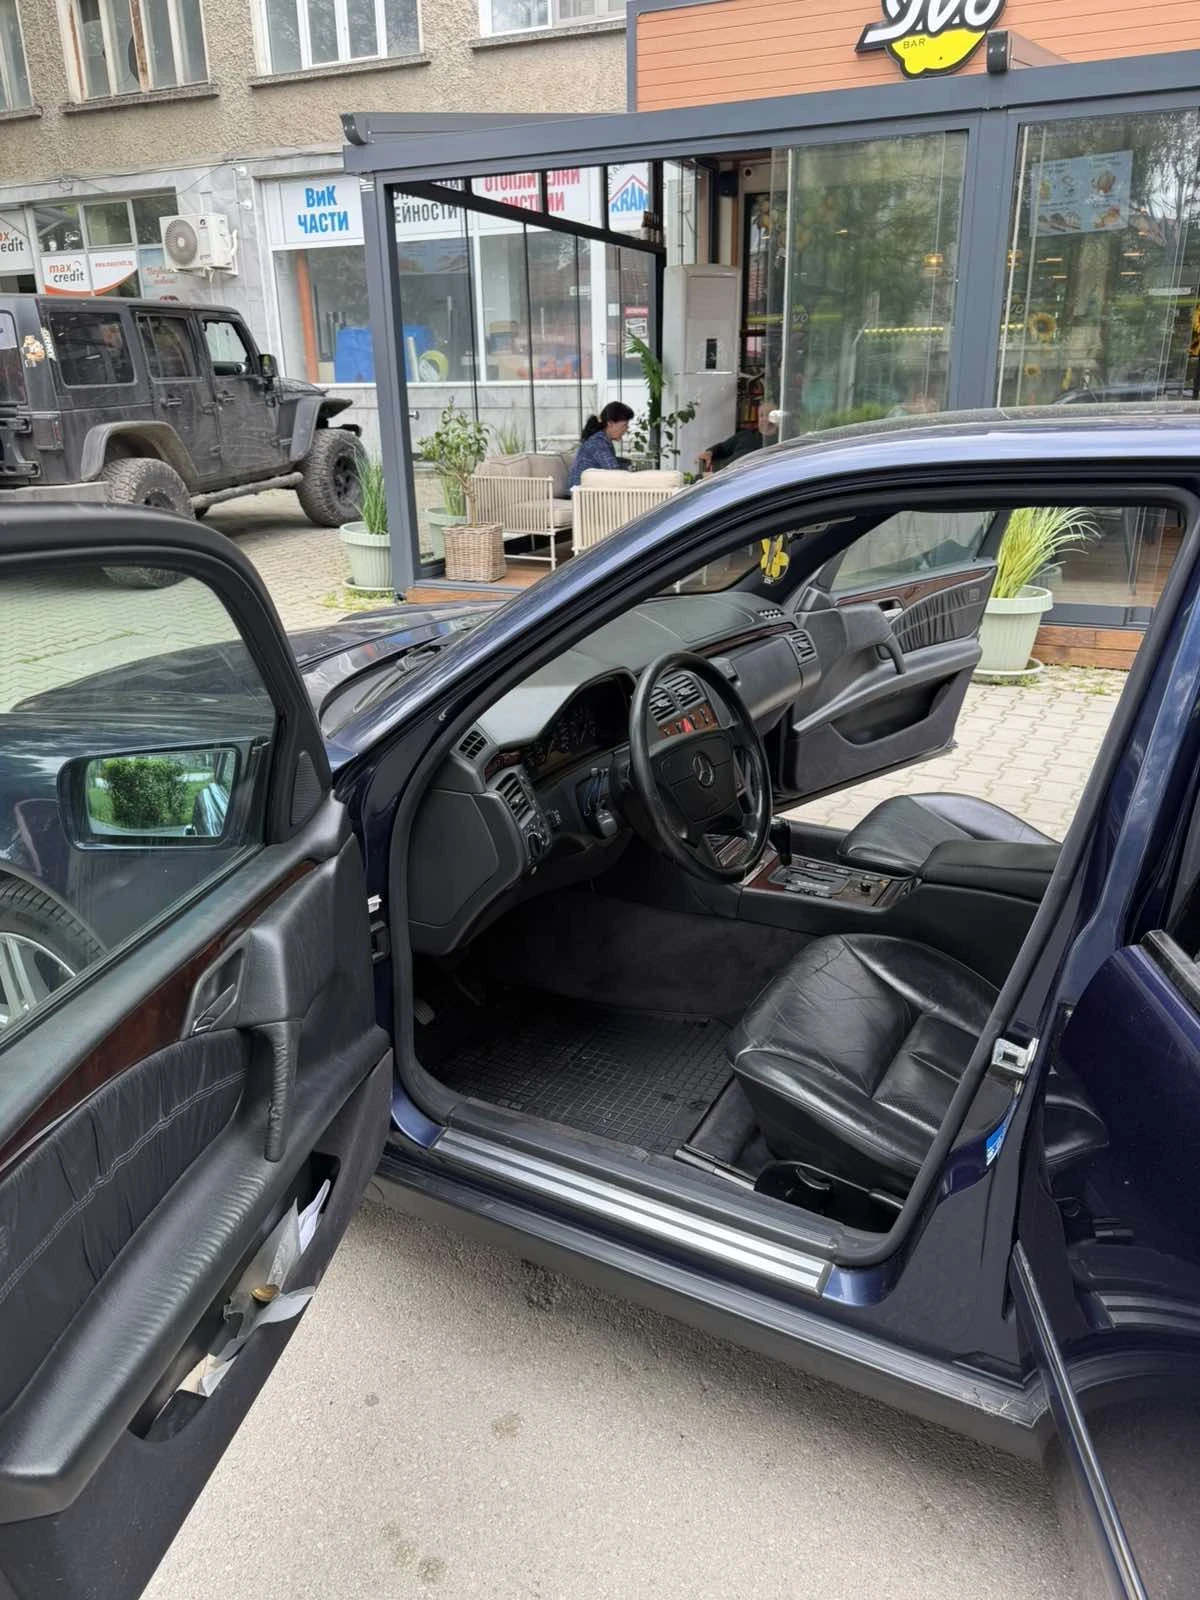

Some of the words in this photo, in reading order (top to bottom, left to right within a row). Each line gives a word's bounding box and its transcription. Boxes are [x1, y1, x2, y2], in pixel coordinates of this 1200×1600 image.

[903, 38, 926, 49] BAR
[305, 185, 337, 208] ВиК
[298, 211, 349, 234] ЧАСТИ
[49, 263, 72, 274] max
[53, 269, 85, 283] credit
